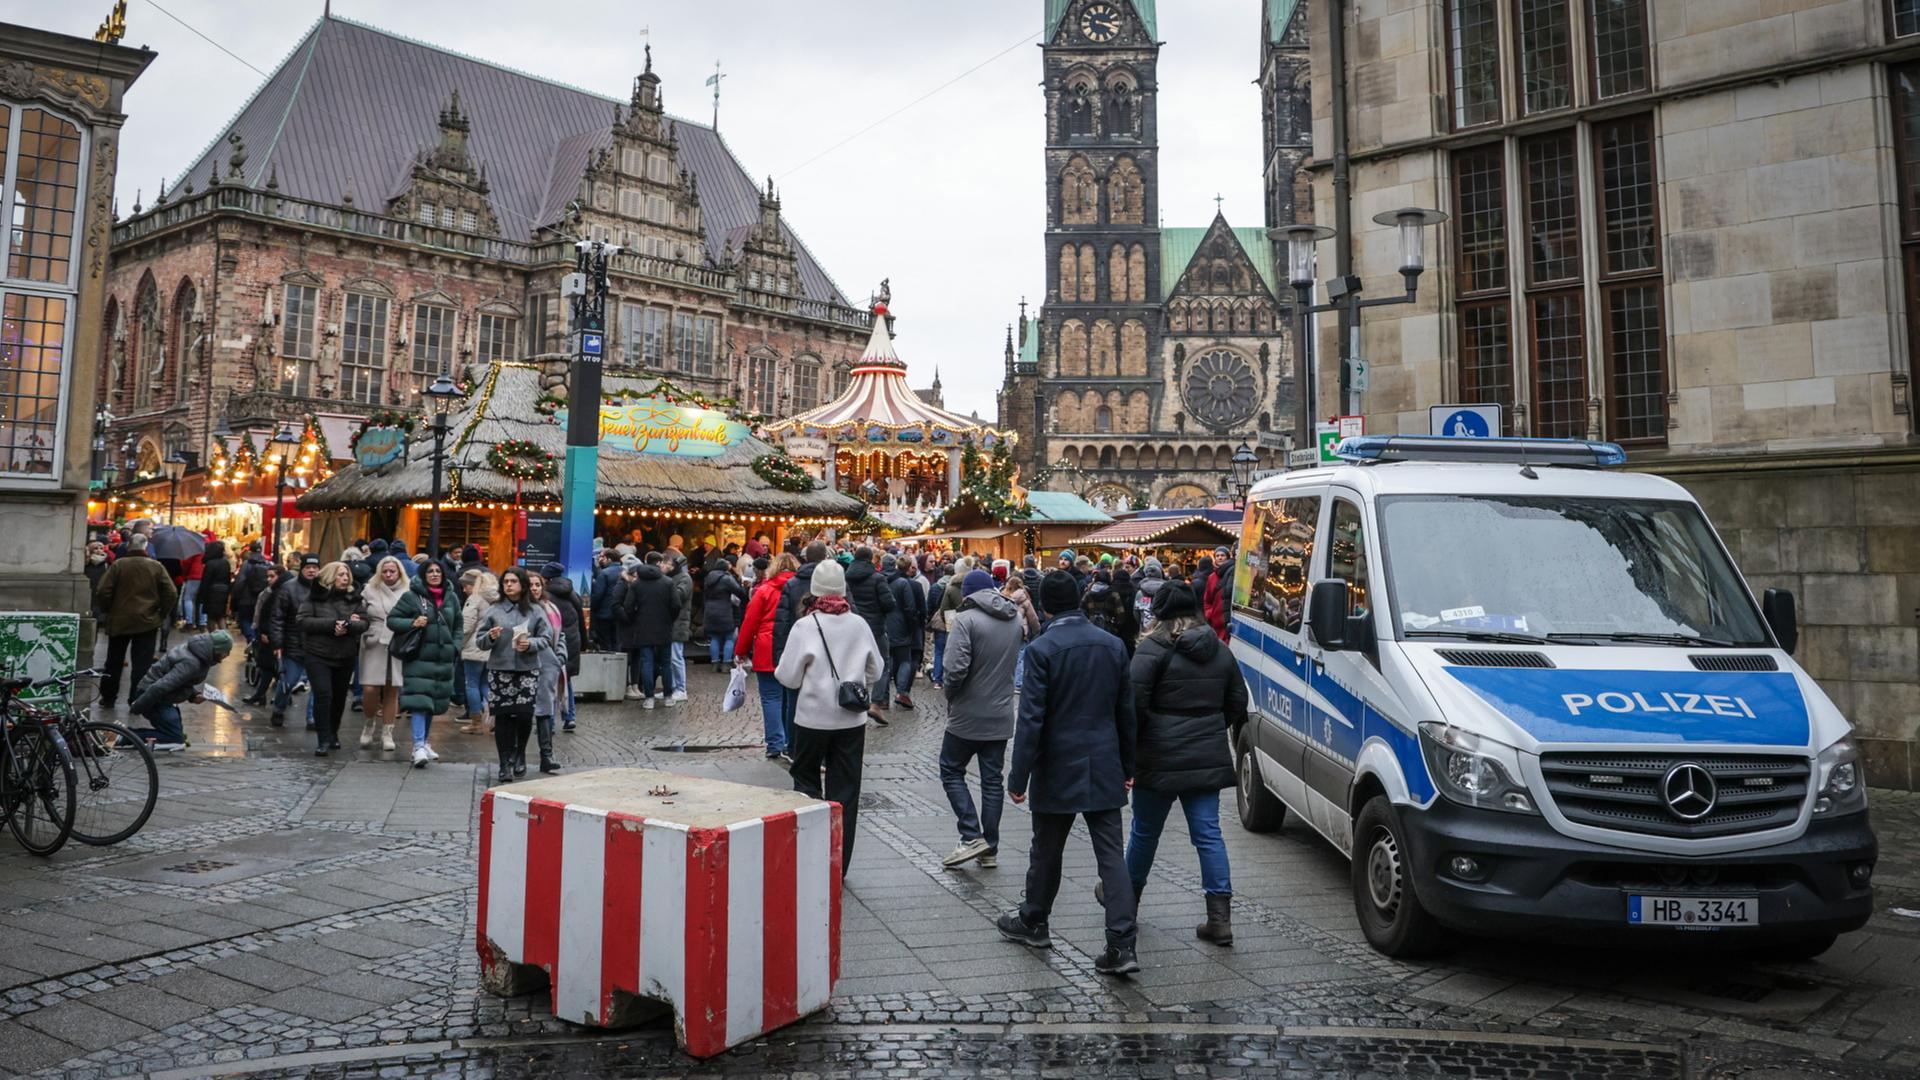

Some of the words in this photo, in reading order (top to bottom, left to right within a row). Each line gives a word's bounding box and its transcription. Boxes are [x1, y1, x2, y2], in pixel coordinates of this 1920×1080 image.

[1268, 687, 1292, 721] POLIZEI
[1560, 691, 1757, 719] POLIZEI
[1653, 900, 1682, 921] HB
[1698, 901, 1748, 922] 3341
